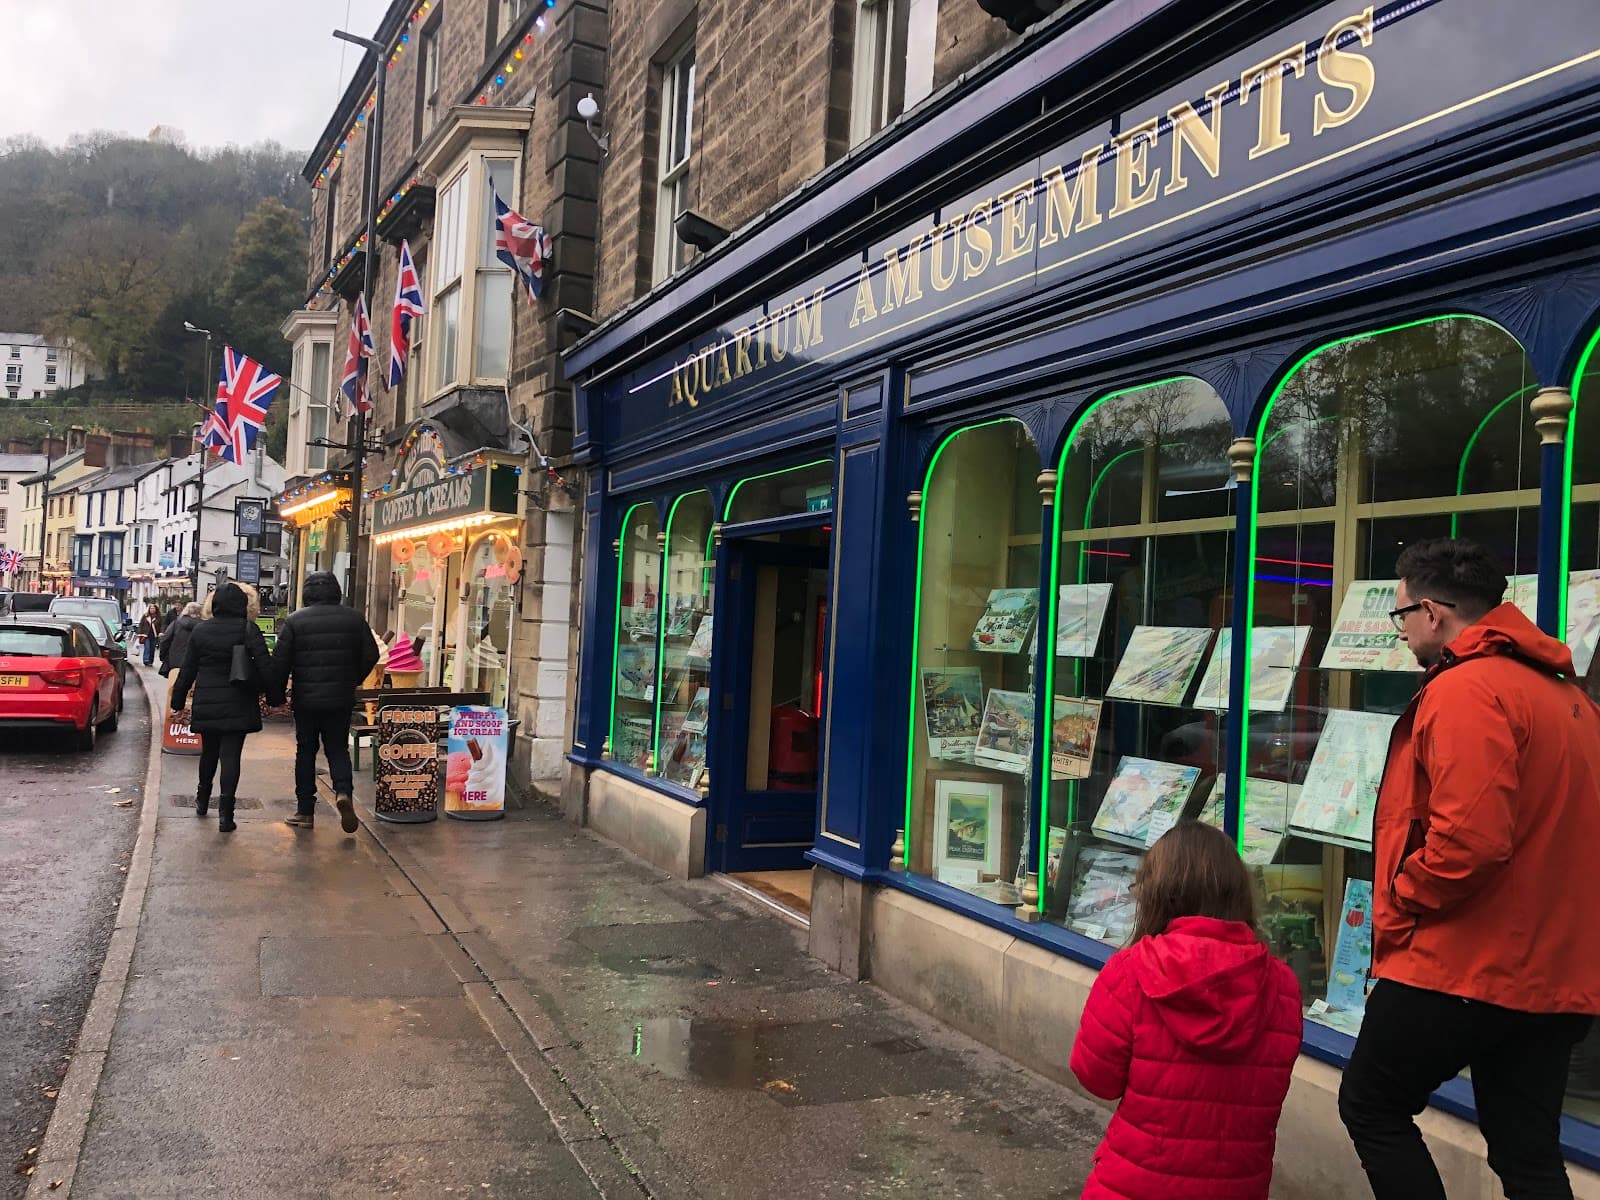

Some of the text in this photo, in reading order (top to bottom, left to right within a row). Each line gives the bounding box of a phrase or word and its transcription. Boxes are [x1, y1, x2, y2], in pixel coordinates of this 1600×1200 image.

[668, 5, 1376, 408] AQUARIUM AMUSEMENTS
[382, 492, 415, 526] COFFEE
[1338, 620, 1362, 632] ARE
[1339, 634, 1396, 647] CLASSY
[1, 676, 22, 685] SFH
[381, 710, 436, 723] FRESH
[459, 711, 497, 720] WHIPPY
[454, 720, 473, 728] AND
[453, 728, 501, 736] ICE CREAM
[379, 743, 438, 761] COFFEE
[459, 791, 488, 801] HERE
